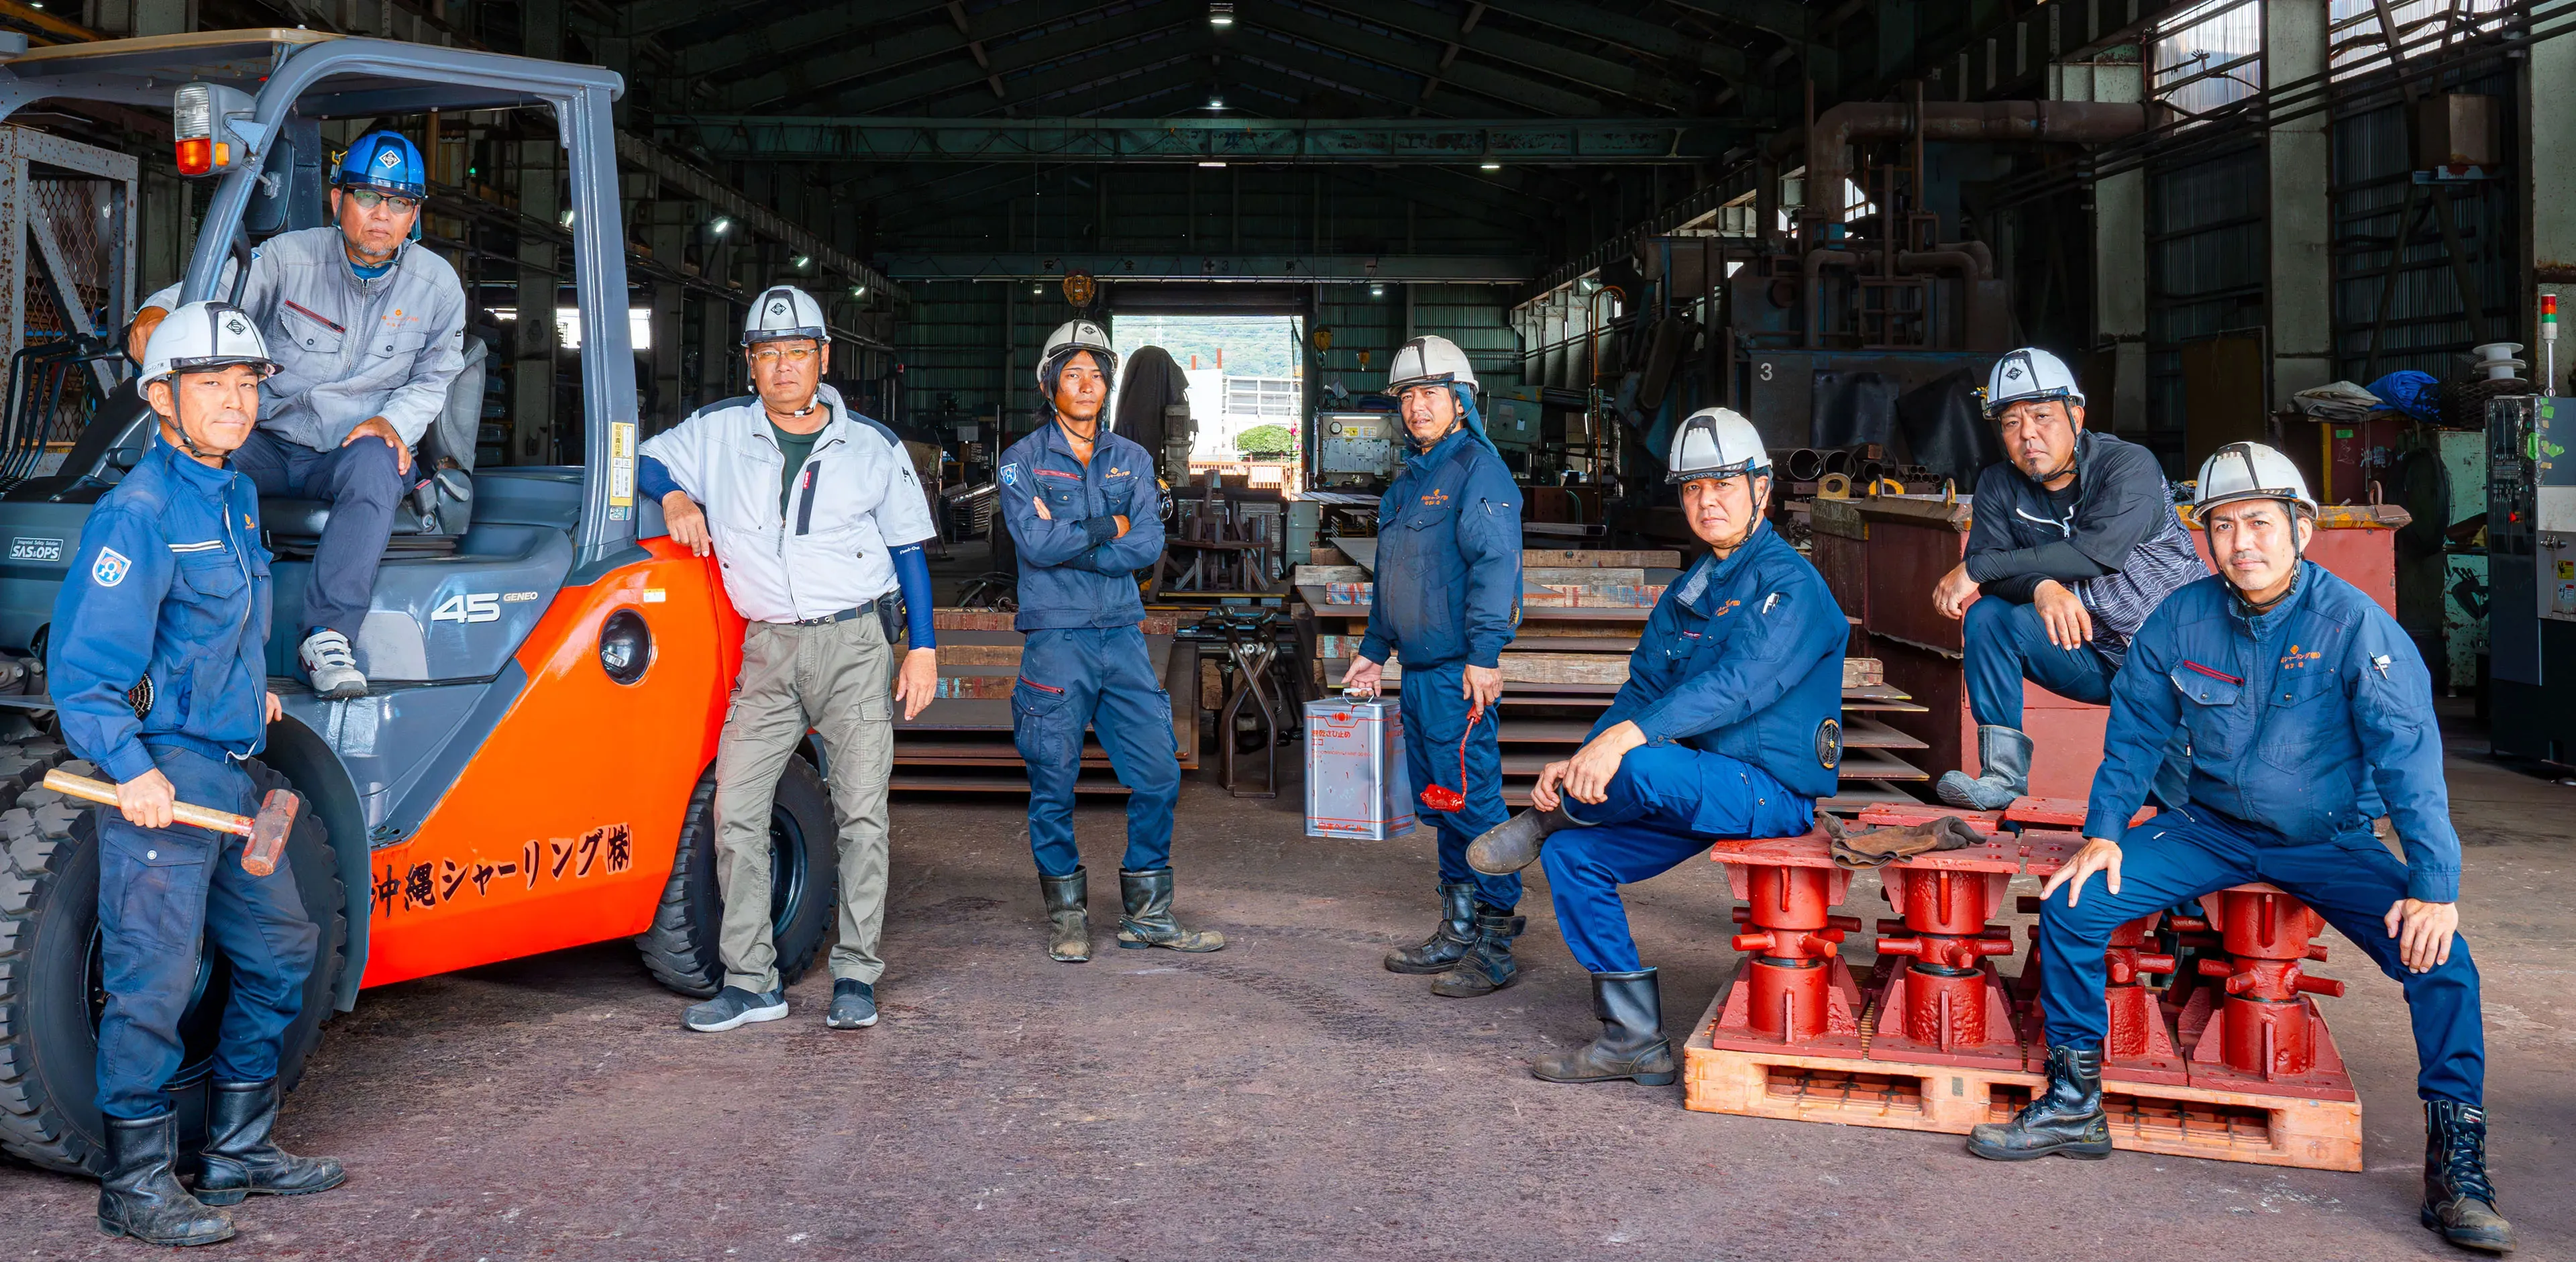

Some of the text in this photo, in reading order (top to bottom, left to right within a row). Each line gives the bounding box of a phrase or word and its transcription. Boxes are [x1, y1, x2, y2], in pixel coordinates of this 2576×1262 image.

[1222, 260, 1229, 271] 3
[1760, 362, 1772, 381] 3
[503, 591, 538, 602] GENEO
[431, 593, 500, 623] 45
